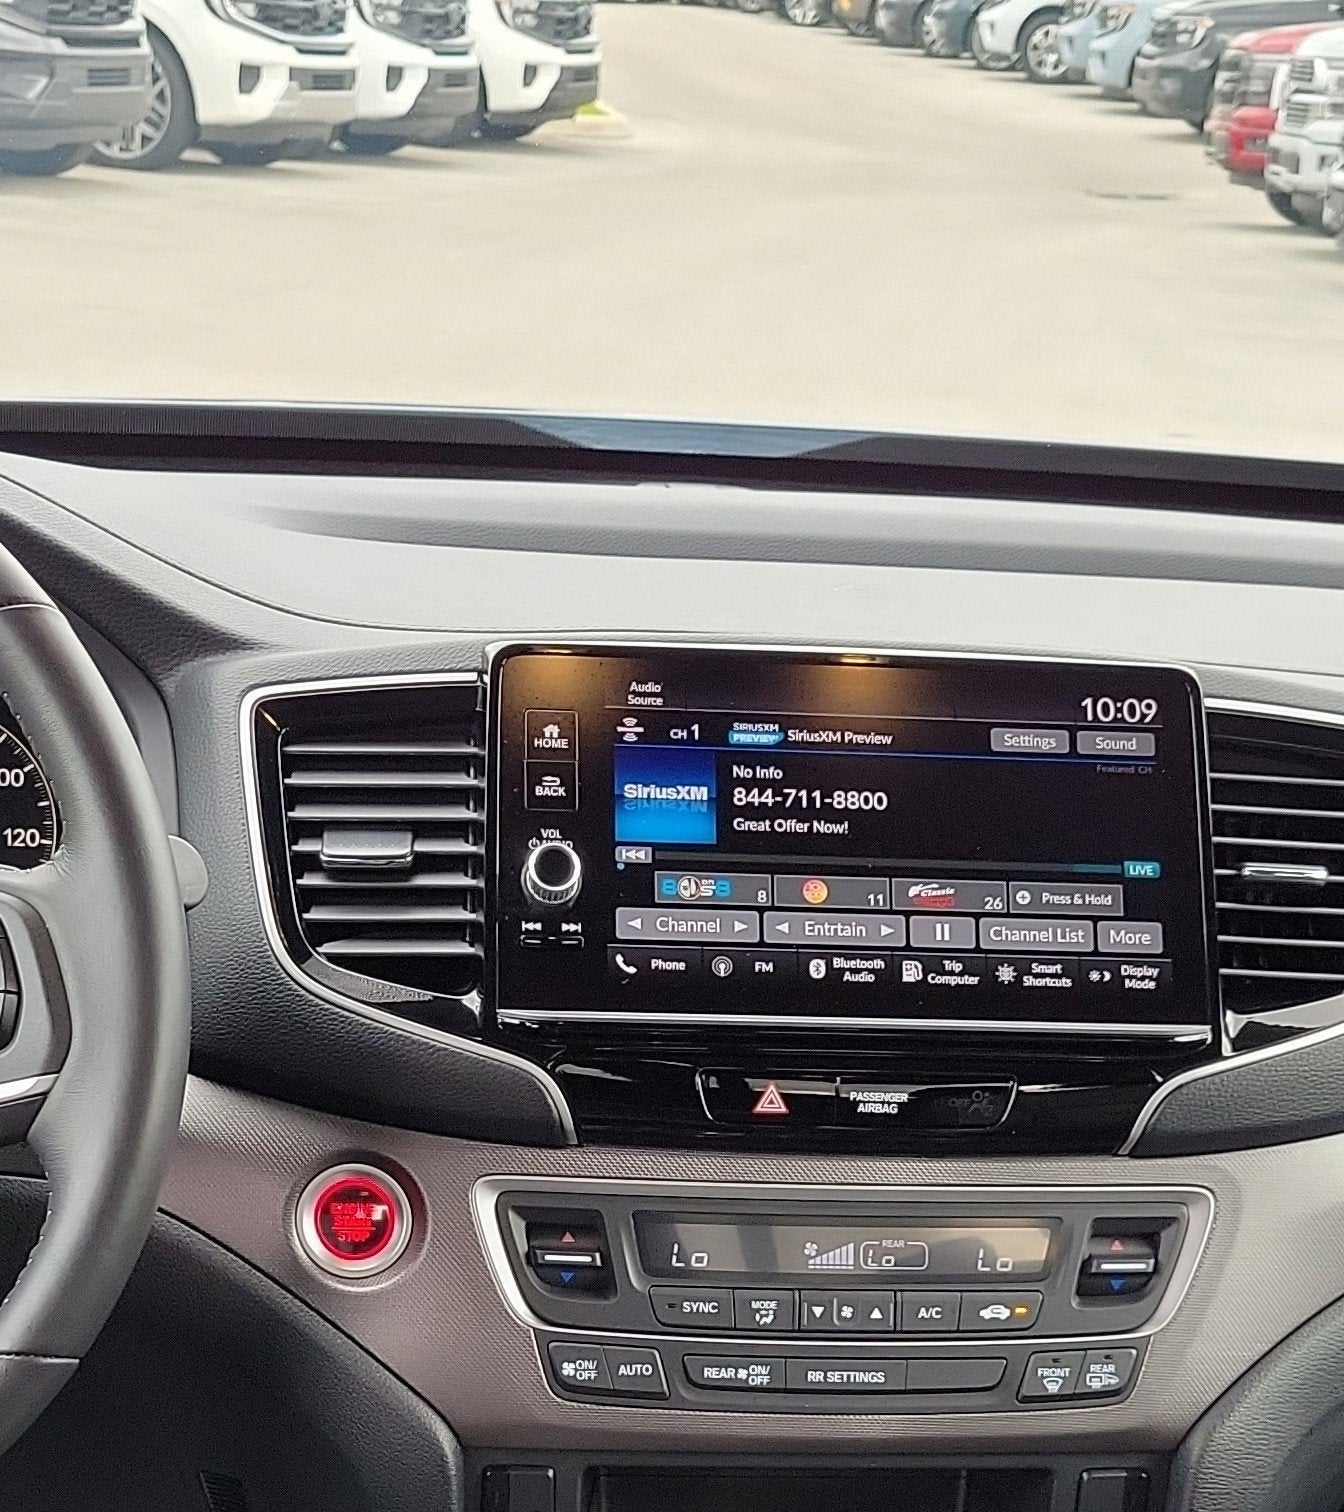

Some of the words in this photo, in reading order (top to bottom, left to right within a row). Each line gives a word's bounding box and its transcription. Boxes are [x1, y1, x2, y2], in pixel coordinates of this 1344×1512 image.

[629, 681, 662, 693] Audio
[627, 695, 663, 706] Source
[1080, 697, 1157, 723] 10:09
[670, 729, 687, 739] CH
[691, 725, 699, 740] 1
[787, 730, 841, 743] SiriusXM
[844, 731, 893, 745] Preview
[534, 738, 569, 749] HOME
[1004, 734, 1056, 749] Settings
[1096, 737, 1137, 750] Sound
[732, 765, 751, 779] No
[757, 766, 783, 780] Info
[535, 786, 566, 797] BACK
[623, 784, 708, 801] SiriusXM
[733, 787, 888, 811] 844-711-8800
[733, 818, 772, 832] Great
[775, 818, 810, 833] Offer
[813, 820, 849, 834] Now!
[2, 828, 40, 848] 120
[540, 828, 563, 839] VOL
[1129, 865, 1154, 876] LIVE
[757, 890, 767, 903] 8
[867, 894, 884, 906] 11
[1042, 893, 1071, 905] Press
[1073, 894, 1083, 905] &
[1085, 894, 1112, 906] Hold
[984, 897, 1003, 910] 26
[656, 916, 721, 933] Channel
[804, 921, 866, 937] Entrtain
[989, 926, 1053, 942] Channel
[1057, 928, 1085, 943] List
[1109, 929, 1151, 944] More
[651, 959, 686, 971] Phone
[755, 962, 774, 973] FM
[833, 958, 885, 970] Bluetooth
[943, 960, 964, 973] Trip
[1031, 963, 1062, 974] Smart
[843, 971, 875, 982] Audio
[1121, 965, 1160, 979] Display
[927, 973, 980, 986] Computer
[1023, 976, 1072, 988] Shortcuts
[1124, 978, 1156, 989] Mode
[849, 1092, 909, 1104] PASSENGER
[857, 1103, 899, 1115] AIRBAG
[337, 1231, 370, 1242] STOP
[881, 1239, 905, 1248] REAR
[682, 1301, 719, 1315] SYNC
[751, 1300, 778, 1311] MODE
[918, 1306, 943, 1320] A/C
[576, 1360, 598, 1370] ON/
[618, 1363, 653, 1377] AUTO
[748, 1365, 771, 1376] ON/
[1089, 1364, 1116, 1374] REAR
[576, 1369, 598, 1381] OFF
[703, 1366, 736, 1379] REAR
[807, 1371, 824, 1382] RR
[826, 1371, 886, 1384] SETTINGS
[1037, 1367, 1071, 1379] FRONT
[748, 1375, 771, 1386] OFF
